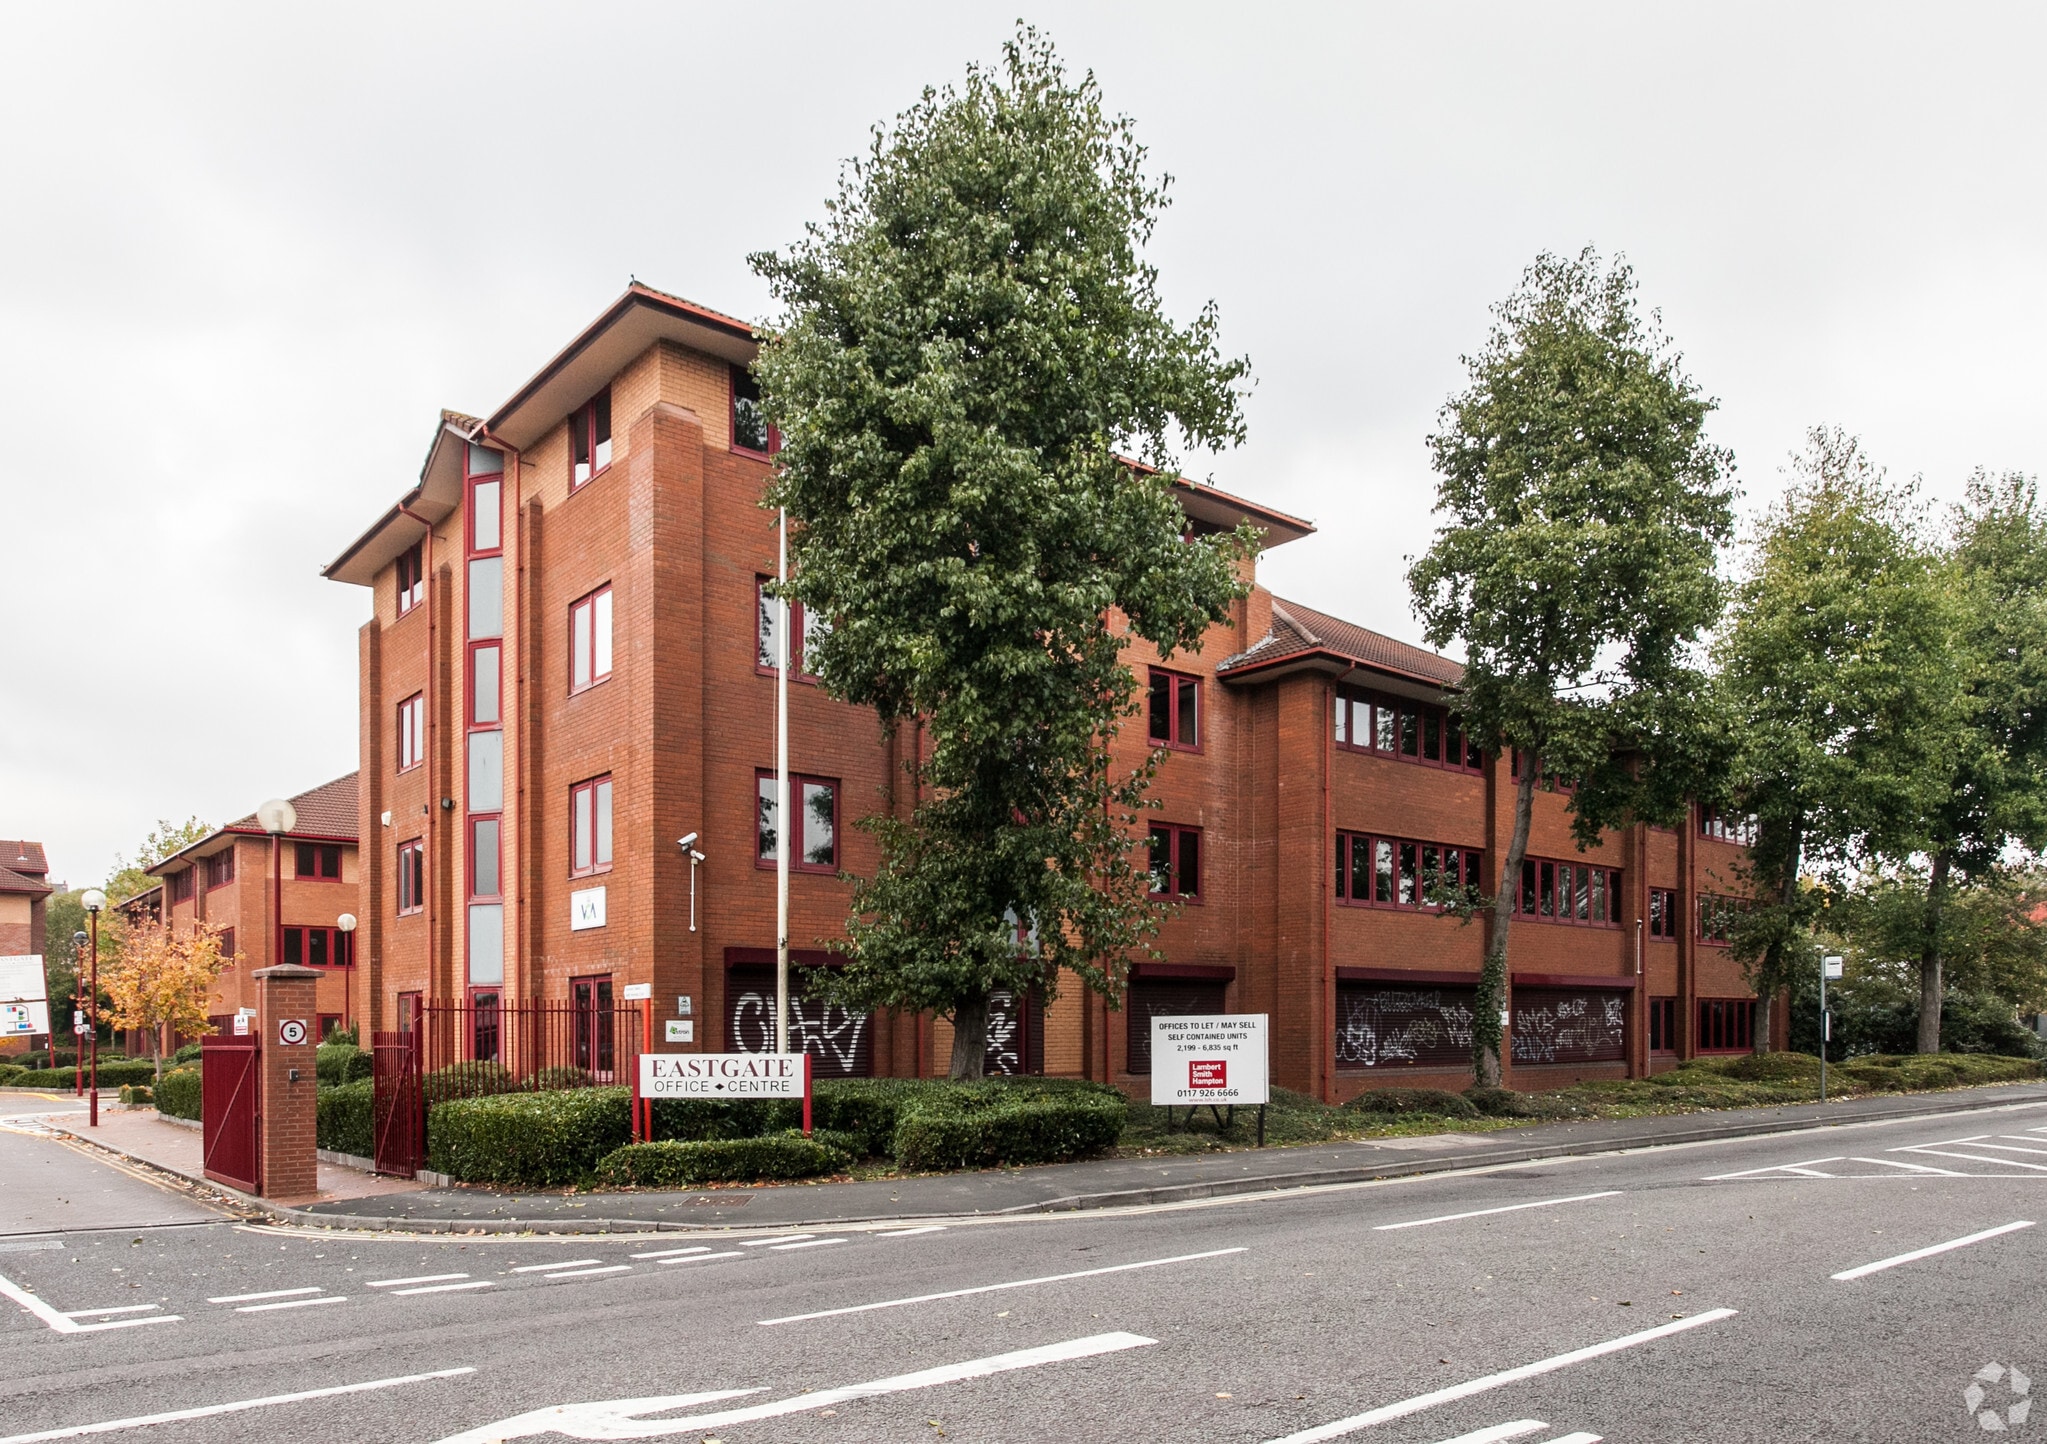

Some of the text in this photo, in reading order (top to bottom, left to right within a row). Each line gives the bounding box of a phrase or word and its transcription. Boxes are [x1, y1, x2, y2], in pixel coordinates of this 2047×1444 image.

[1159, 1022, 1188, 1030] OFFICES
[1190, 1022, 1199, 1030] TO
[1201, 1022, 1214, 1030] LET
[1221, 1021, 1237, 1029] MAY
[1239, 1021, 1256, 1029] SELL
[289, 1027, 297, 1037] 5
[1168, 1033, 1184, 1041] SELF
[1227, 1032, 1248, 1040] UNITS
[1202, 1044, 1221, 1052] 6,835
[652, 1059, 794, 1078] EASTGATE
[1192, 1063, 1221, 1071] Lambert
[1192, 1070, 1213, 1078] Smith
[654, 1080, 790, 1092] OFFICE CENTRE
[1192, 1078, 1224, 1086] Hampton
[1199, 1089, 1215, 1097] 926
[1217, 1089, 1239, 1097] 6666
